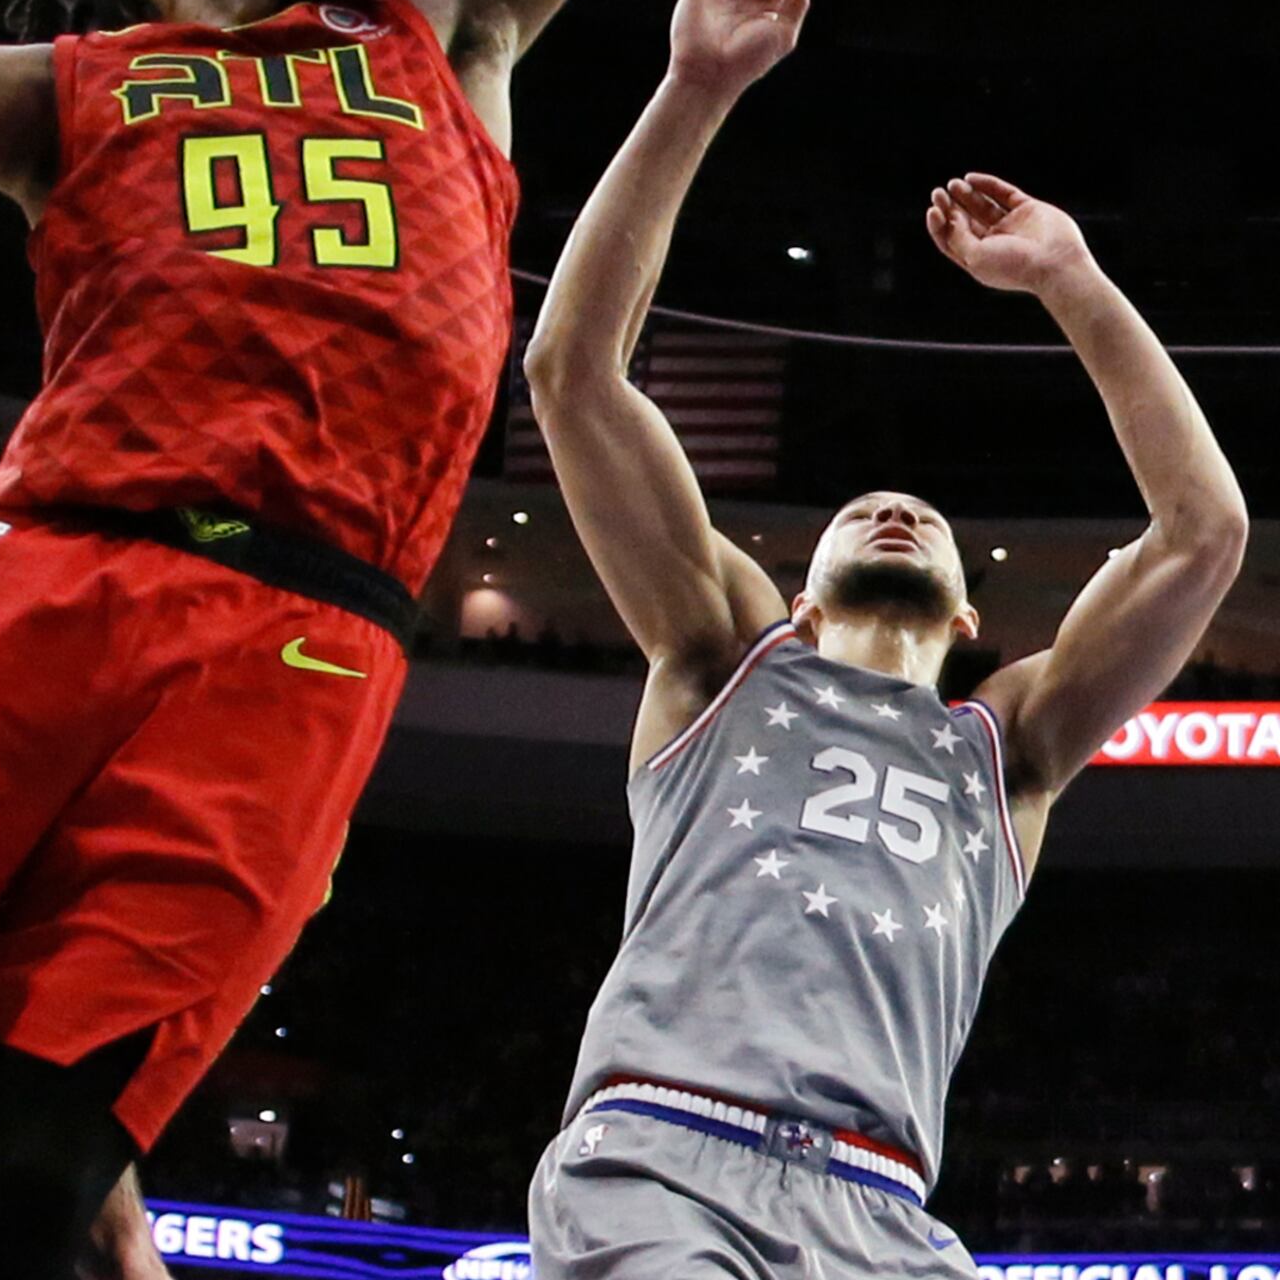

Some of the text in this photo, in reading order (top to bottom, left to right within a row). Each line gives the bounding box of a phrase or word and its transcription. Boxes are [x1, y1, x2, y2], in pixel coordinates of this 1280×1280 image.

[110, 42, 425, 131] ATL
[179, 132, 400, 271] 95
[800, 747, 950, 865] 25
[148, 1210, 286, 1264] 6ERS
